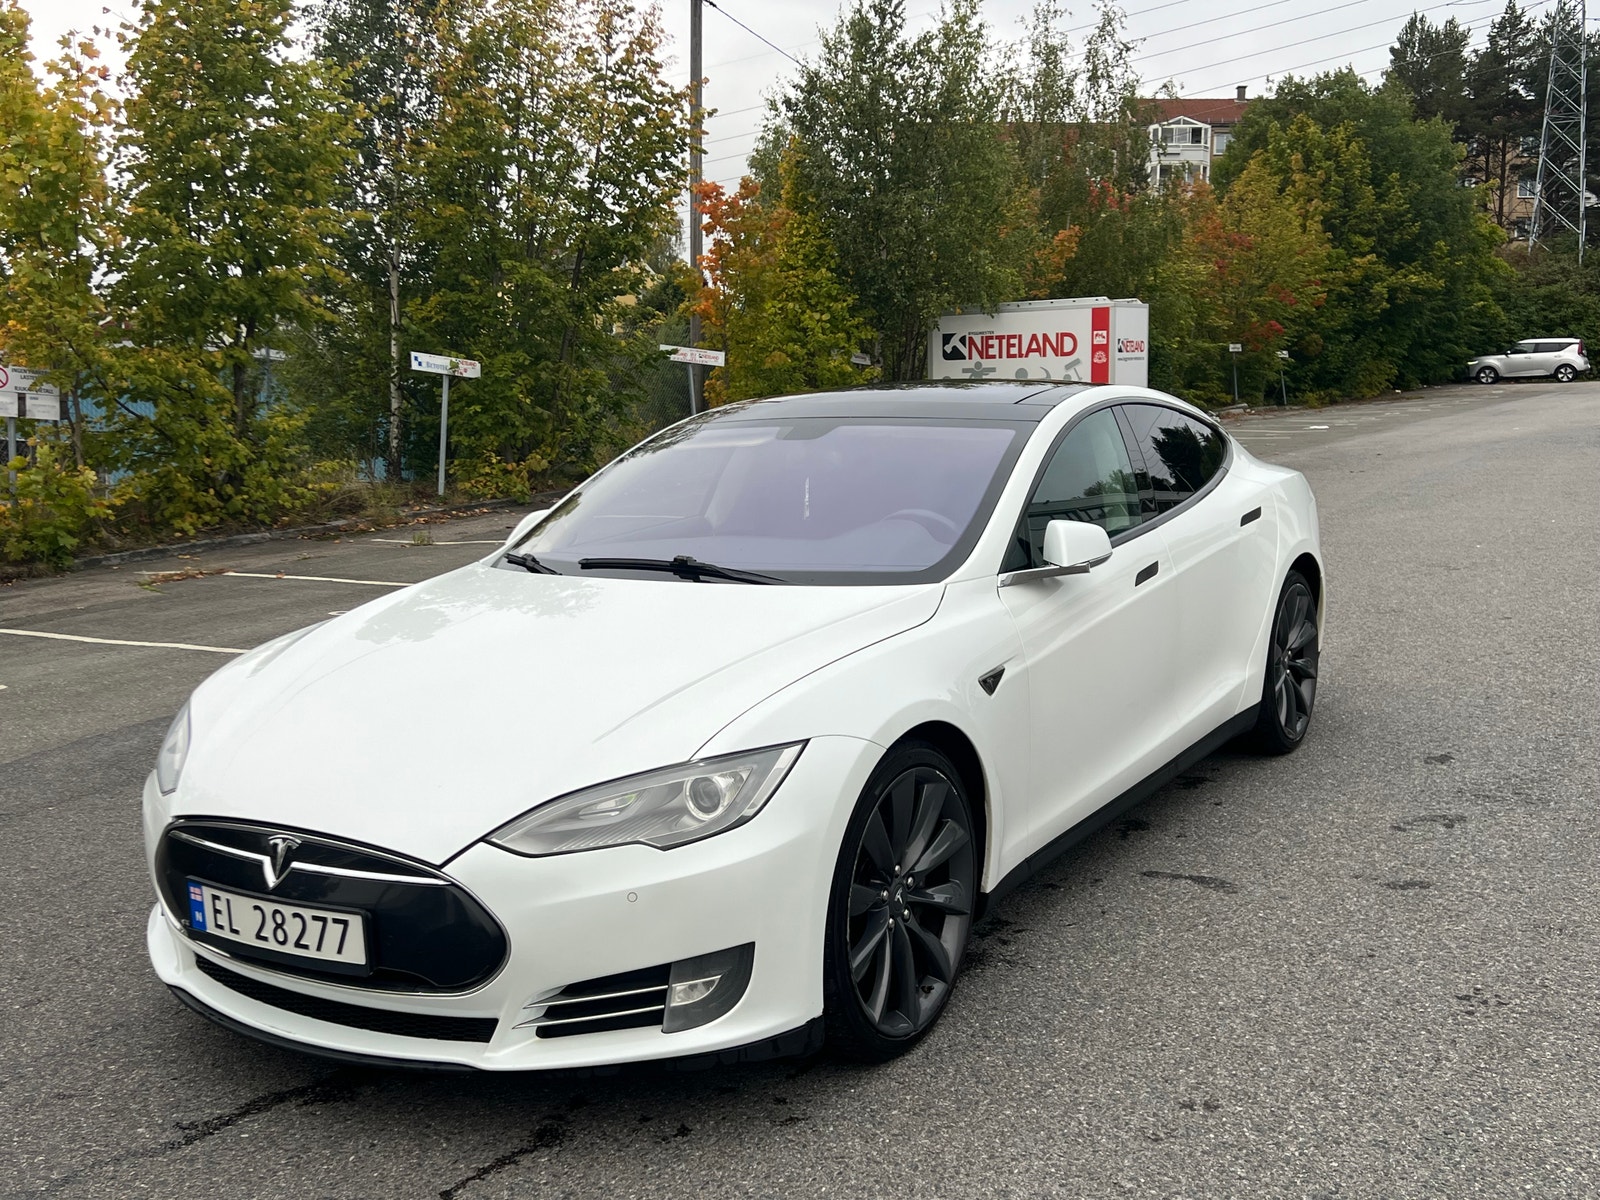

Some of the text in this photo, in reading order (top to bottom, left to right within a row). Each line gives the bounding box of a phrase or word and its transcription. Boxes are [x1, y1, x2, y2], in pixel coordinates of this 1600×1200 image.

[968, 332, 1078, 360] NETELAND
[211, 893, 349, 955] EL 28277
